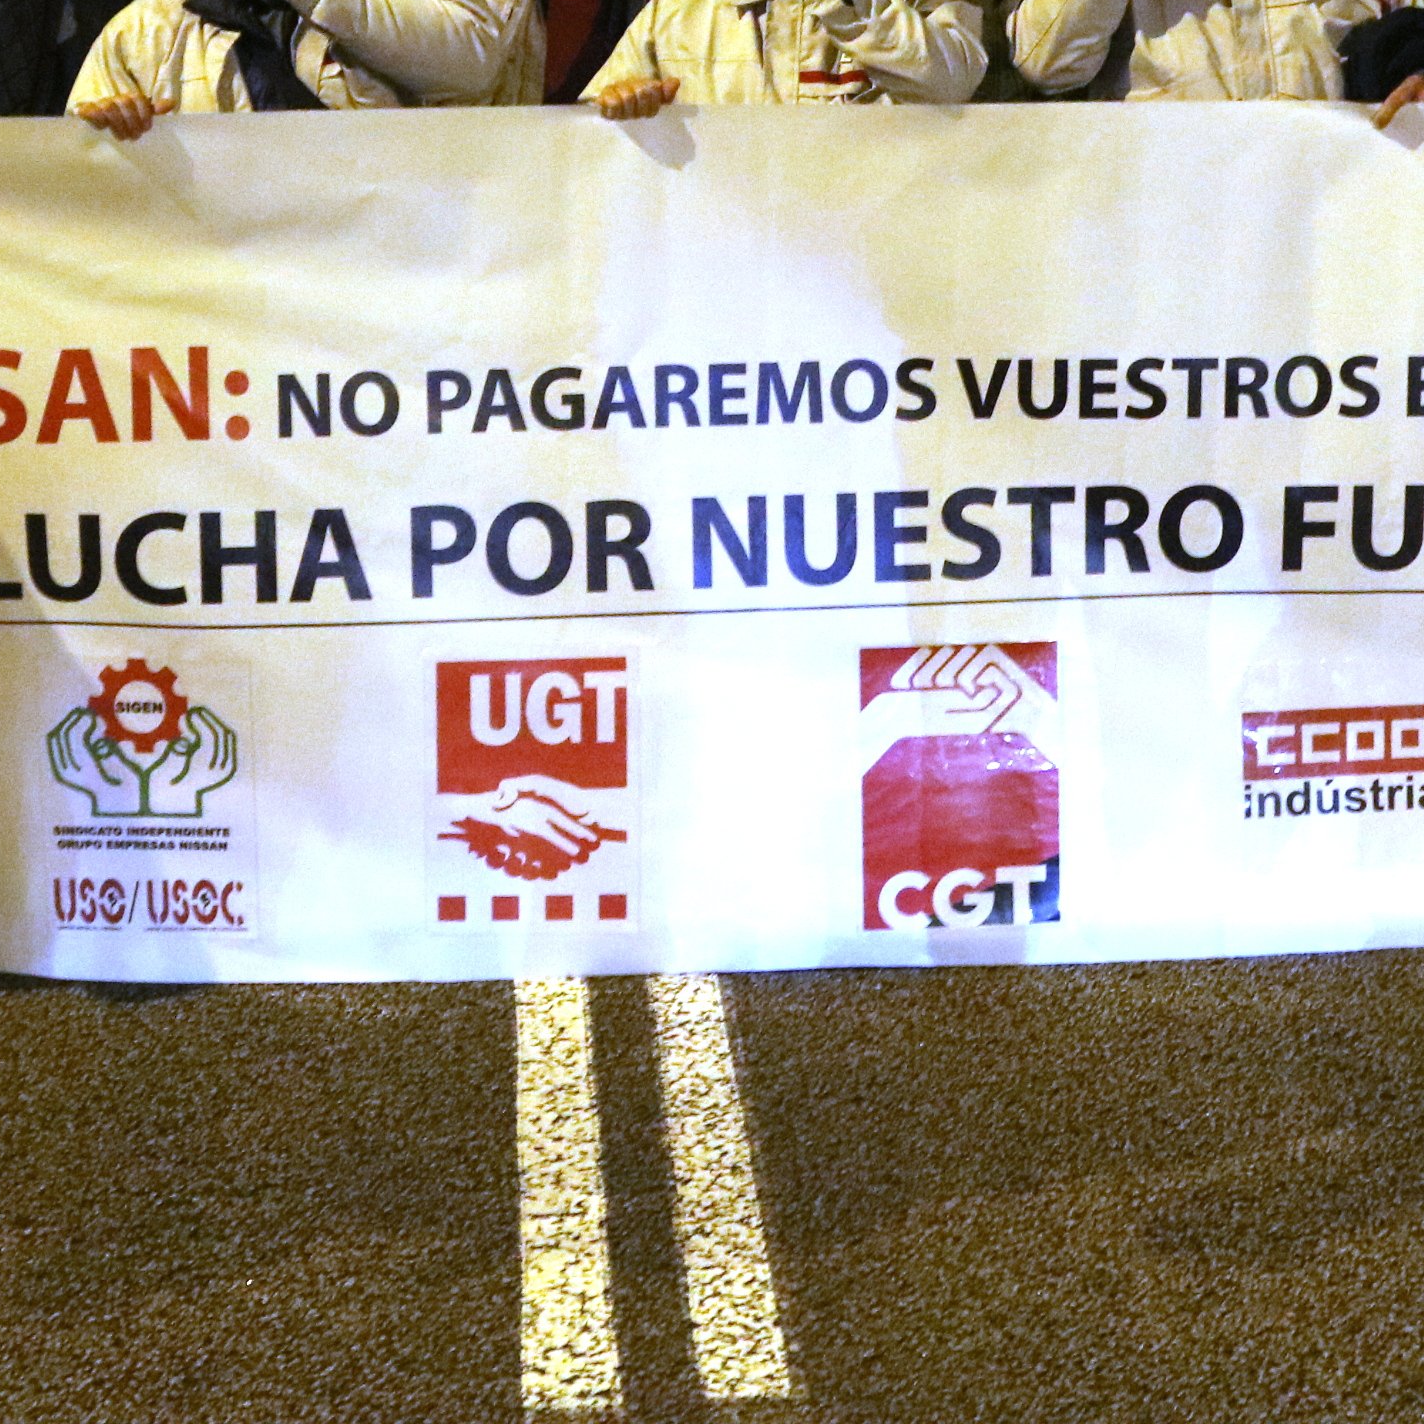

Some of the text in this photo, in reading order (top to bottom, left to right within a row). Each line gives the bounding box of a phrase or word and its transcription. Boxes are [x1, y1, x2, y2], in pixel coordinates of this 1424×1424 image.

[276, 371, 400, 438] NO
[425, 357, 937, 435] PAGAREMOS
[956, 353, 1381, 420] VUESTROS
[410, 498, 655, 598] POR
[692, 484, 1245, 589] NUESTRO
[115, 701, 163, 714] SIGEN
[469, 670, 626, 746] UGT
[53, 826, 231, 838] SINDICATO INDEPENDIENTE
[57, 839, 228, 852] GRUPO EMPRESAS NISSAN
[877, 863, 1047, 929] CGT
